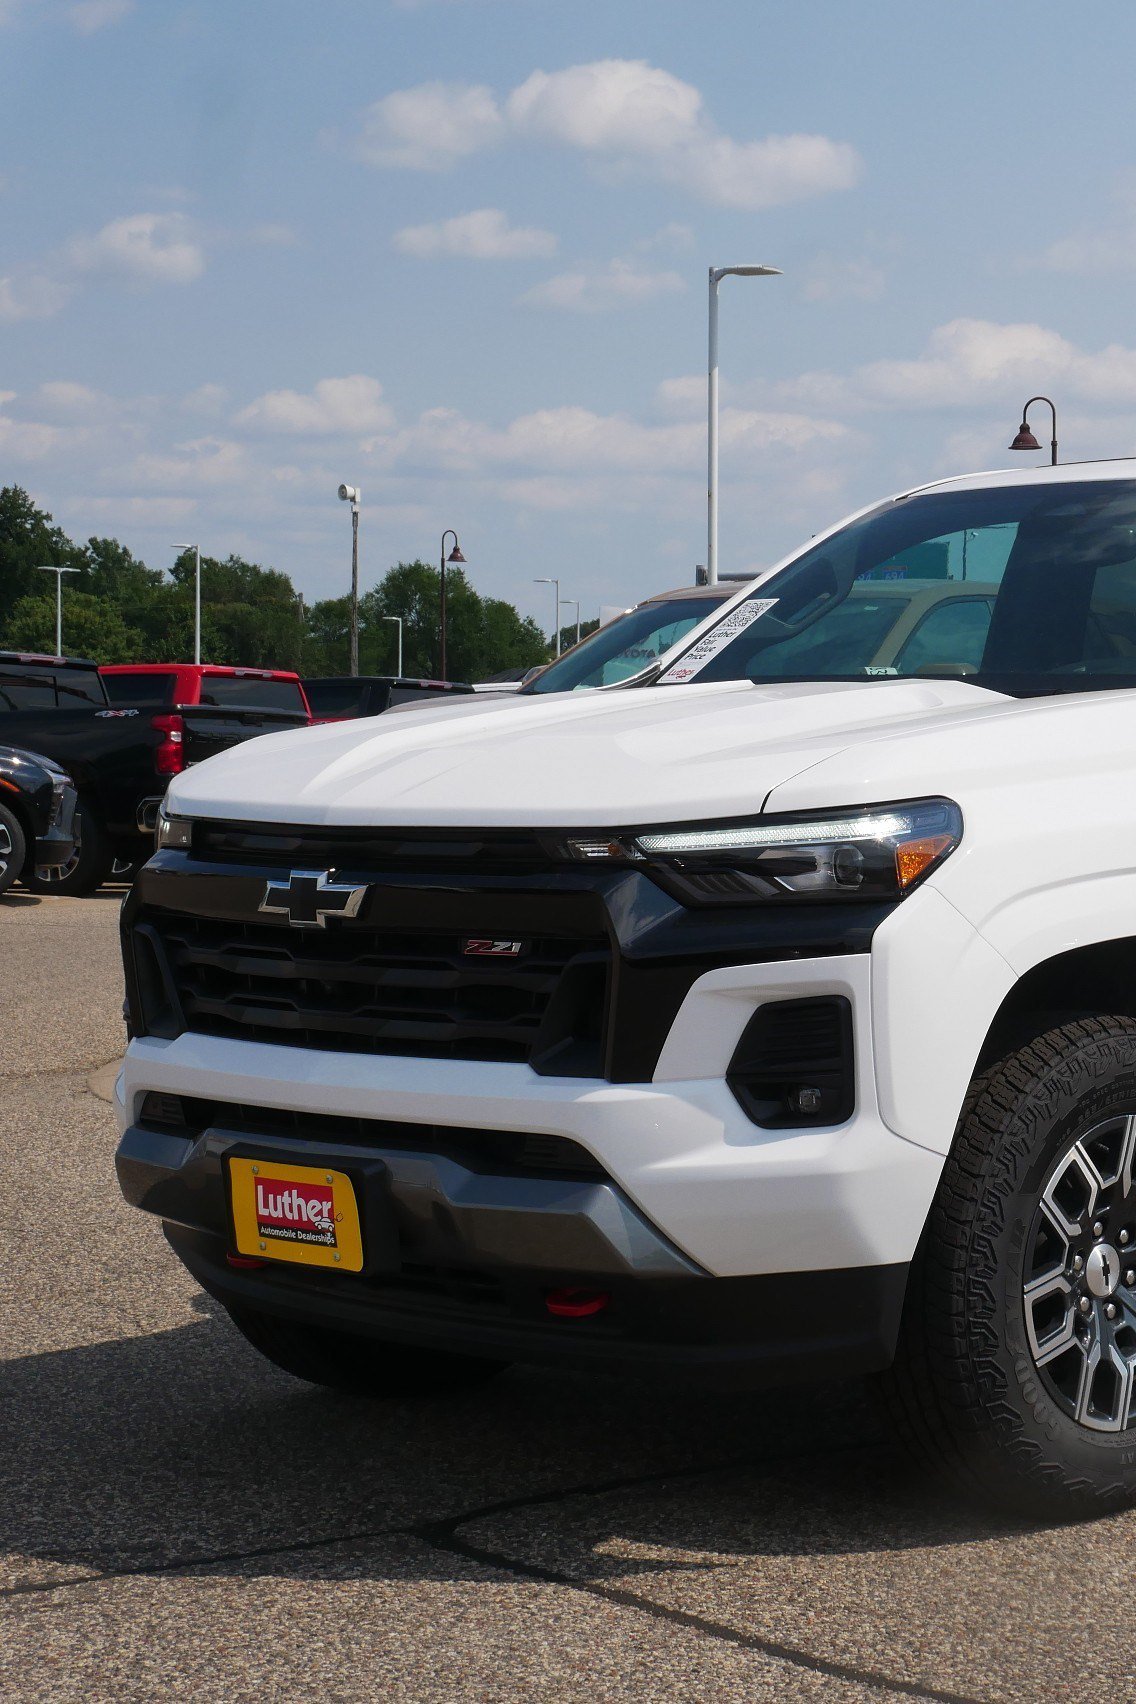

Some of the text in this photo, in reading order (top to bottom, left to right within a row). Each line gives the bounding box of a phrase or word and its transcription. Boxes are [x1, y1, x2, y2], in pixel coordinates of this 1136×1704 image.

[667, 669, 695, 677] Luther
[464, 940, 521, 956] Z71
[257, 1185, 332, 1222] Luther
[260, 1226, 335, 1245] Automobile Dealerships
[1119, 1452, 1135, 1465] AT
